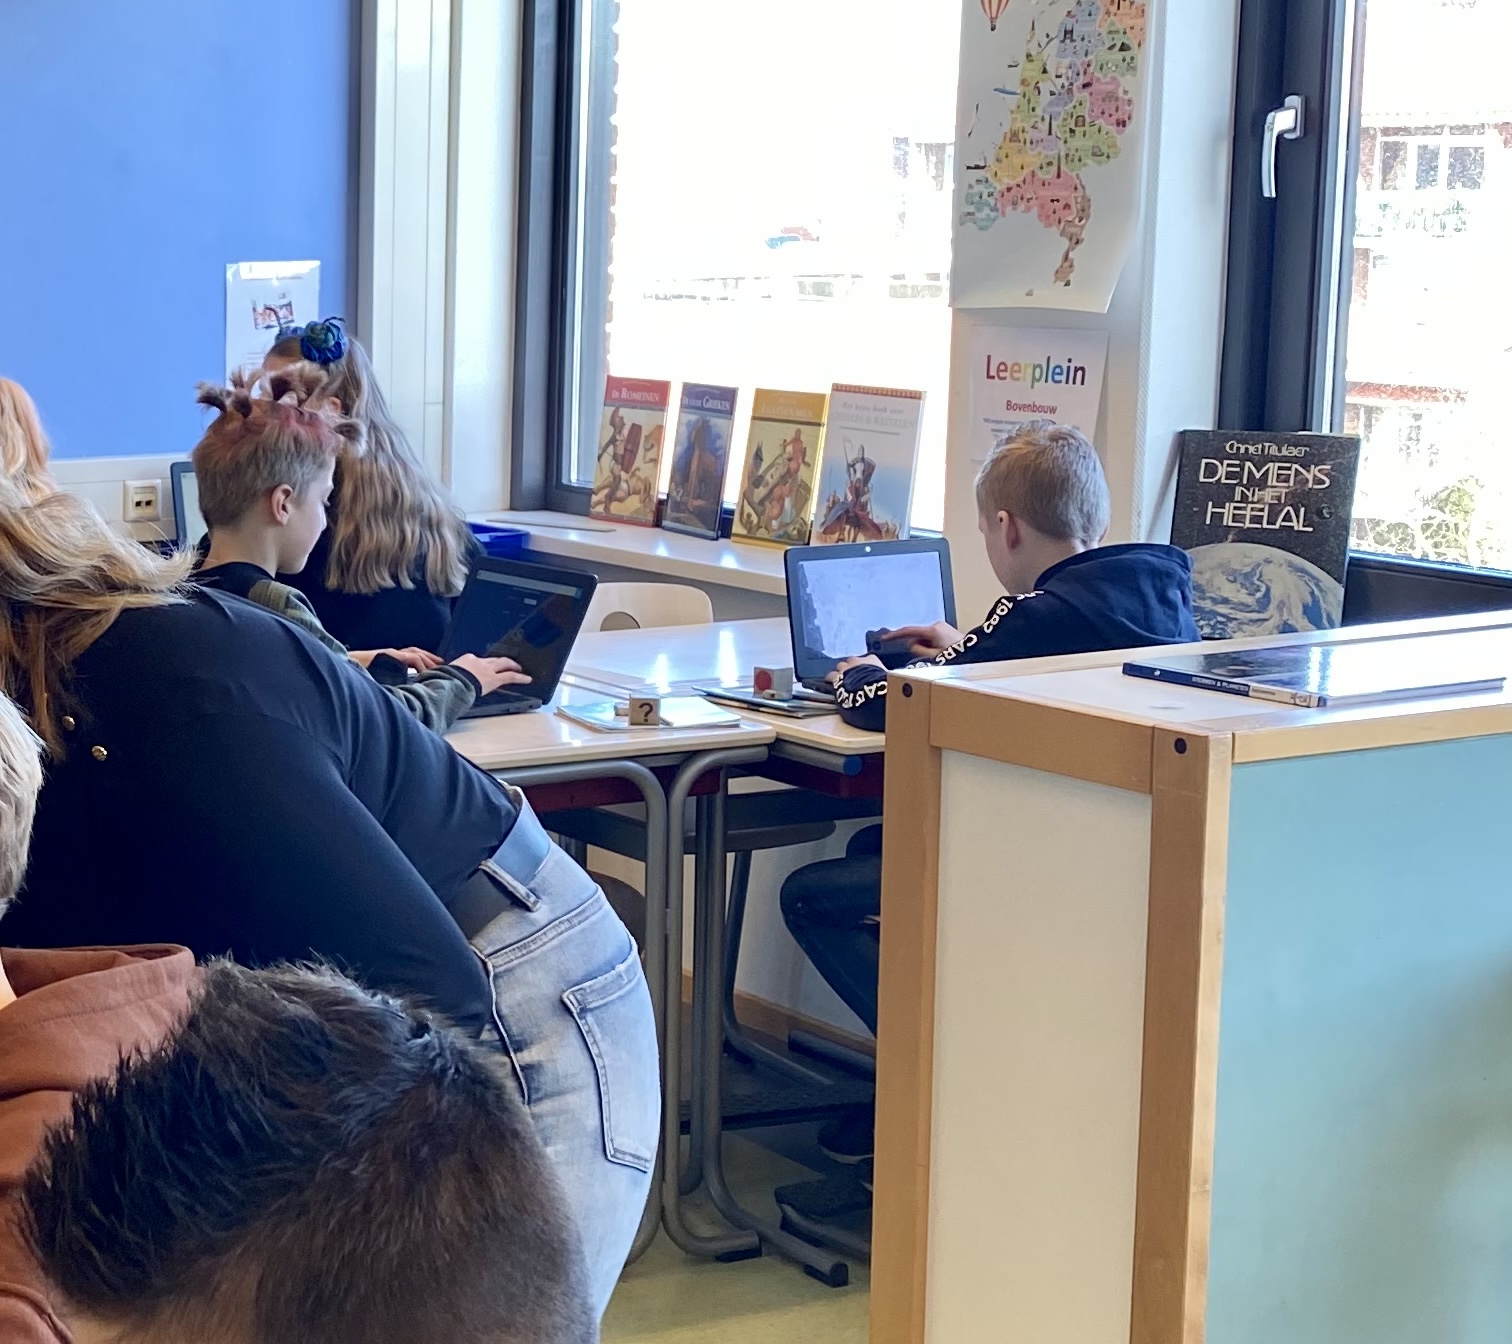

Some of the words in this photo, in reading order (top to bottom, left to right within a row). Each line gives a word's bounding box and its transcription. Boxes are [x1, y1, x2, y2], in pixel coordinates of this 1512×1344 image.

[986, 354, 1086, 389] Leerplein
[1006, 399, 1058, 415] Bovenbouw
[1199, 458, 1240, 484] DE
[1243, 461, 1331, 489] MENS
[1234, 486, 1254, 502] IN
[1254, 488, 1289, 504] HET
[1205, 501, 1313, 532] HEELAL
[936, 633, 978, 666] CARS
